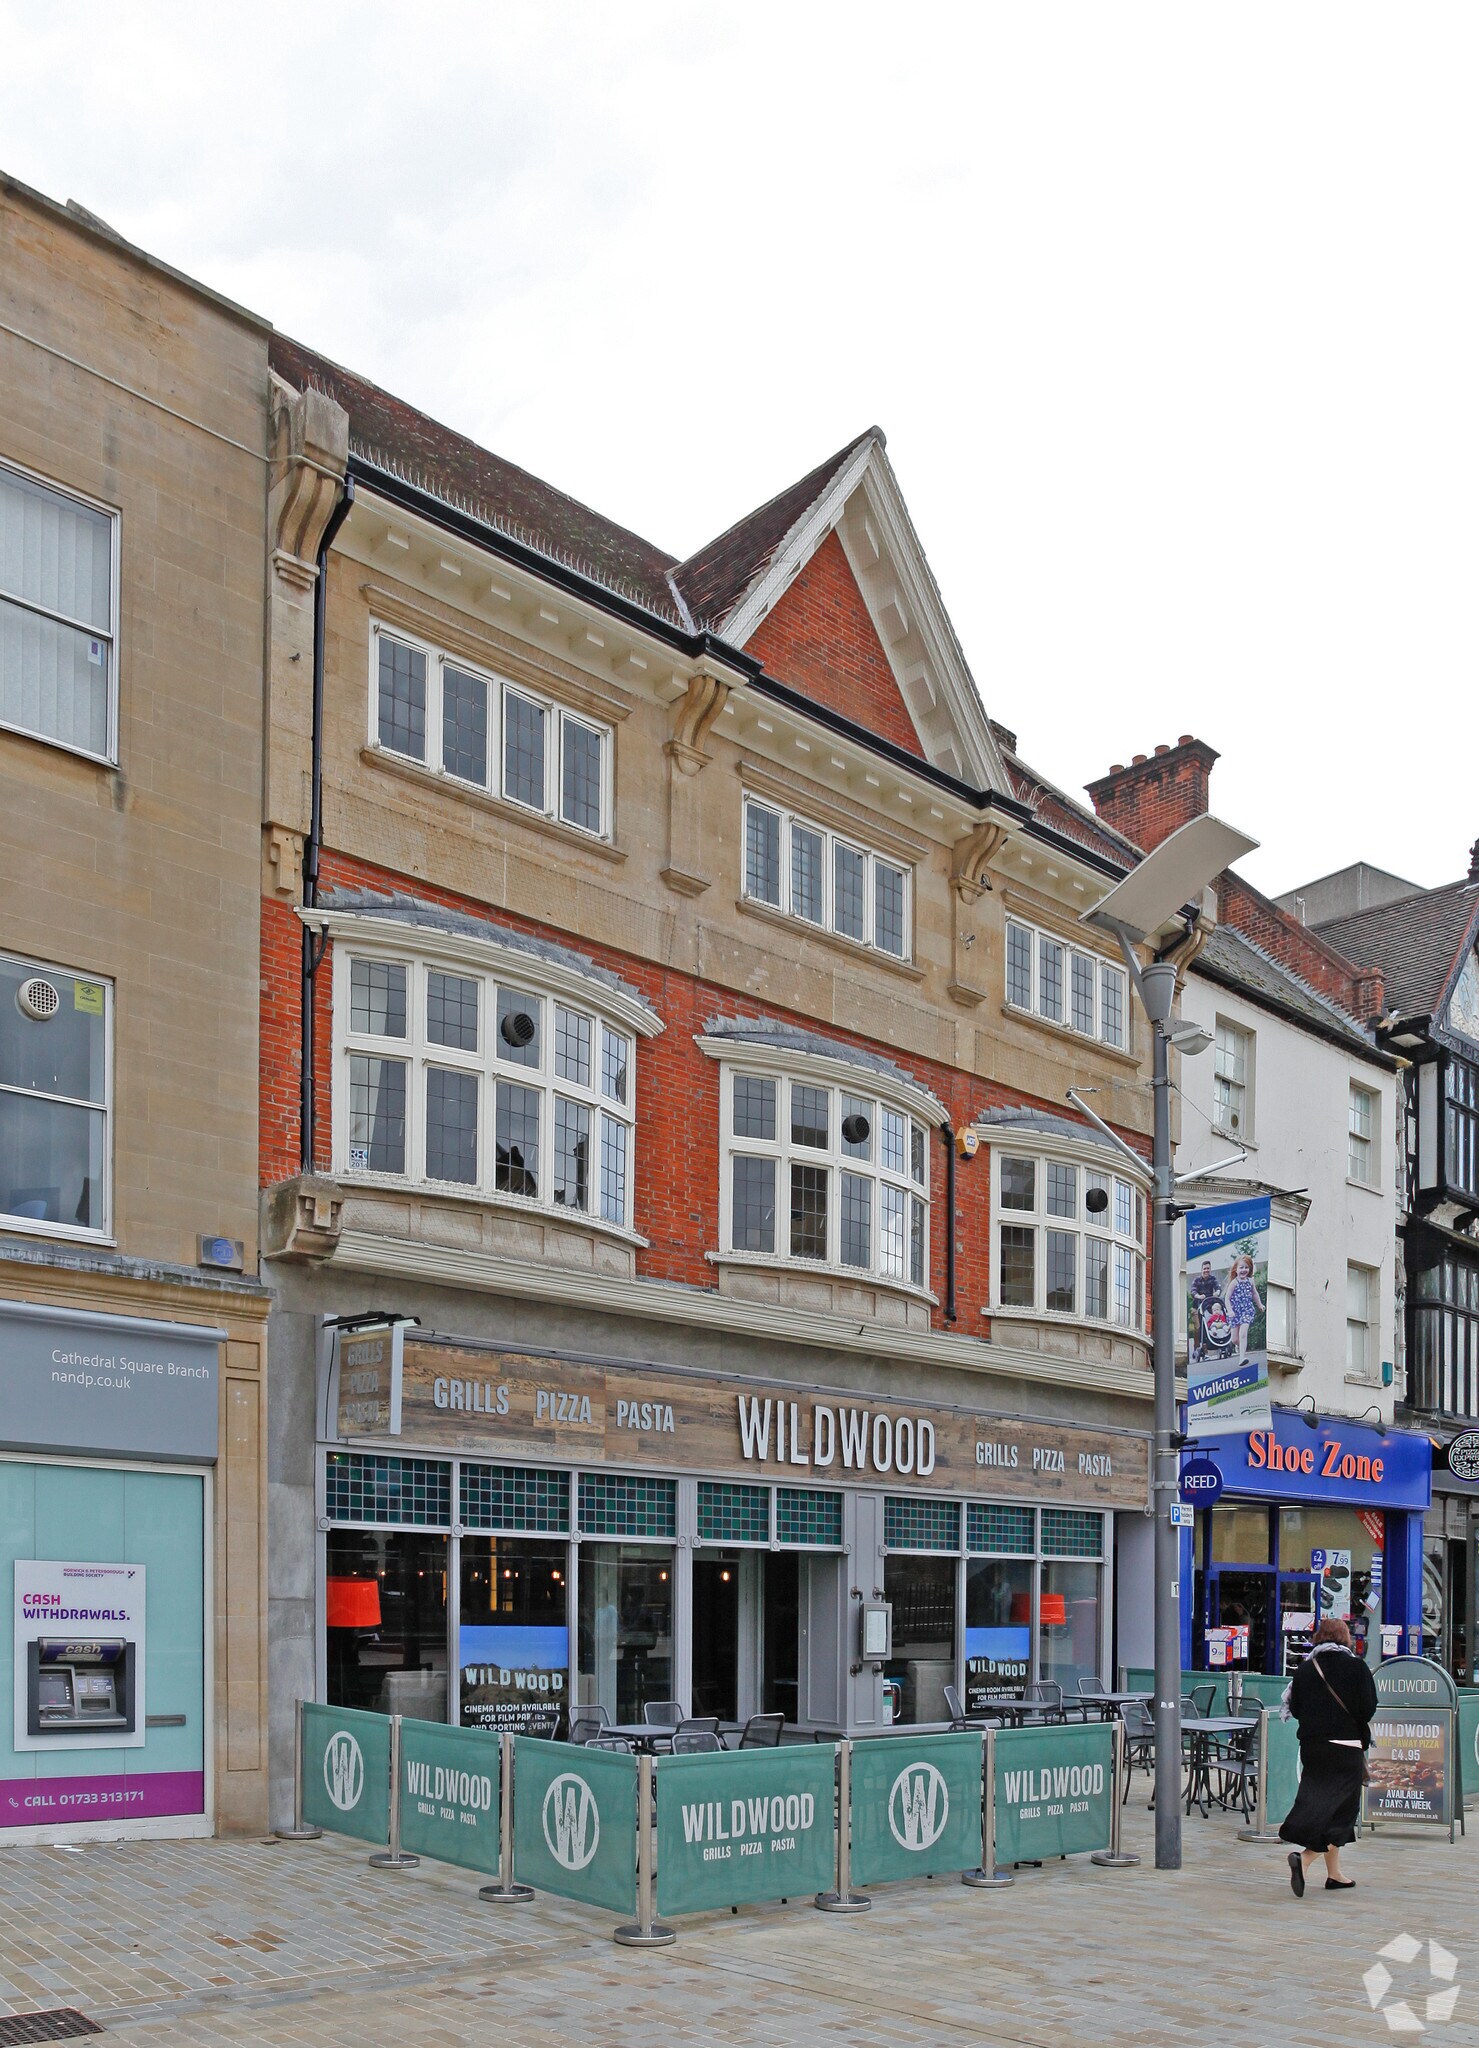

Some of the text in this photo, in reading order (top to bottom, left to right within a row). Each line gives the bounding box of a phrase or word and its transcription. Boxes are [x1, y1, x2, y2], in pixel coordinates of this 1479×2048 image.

[348, 1341, 383, 1367] GRILLS
[52, 1349, 209, 1379] Cathedral Square Branch
[51, 1371, 131, 1389] nandp.co.uk
[351, 1371, 379, 1394] PIZZA
[1193, 1376, 1250, 1400] Walking...
[433, 1377, 675, 1433] GRILLS PIZZA PASTA
[738, 1395, 935, 1476] WILDWOOD
[975, 1441, 1112, 1477] GRILLS PIZZA PASTA
[1248, 1430, 1384, 1483] Shoe Zone
[1184, 1475, 1217, 1489] REED
[23, 1594, 61, 1605] CASH
[23, 1608, 130, 1620] WITHDRAWALS.
[65, 1643, 101, 1655] cash
[1378, 1679, 1437, 1693] WILDWOOD
[464, 1702, 560, 1713] CINEMA ROOM AVAILABLE
[480, 1714, 495, 1723] FOR
[498, 1713, 515, 1722] FILM
[489, 1723, 526, 1731] SPORTING
[1373, 1722, 1440, 1738] WILDWOOD
[1419, 1739, 1440, 1748] PIZZA
[1391, 1748, 1421, 1761] £4.95
[407, 1760, 491, 1811] WILDWOOD
[1004, 1764, 1104, 1804] WILDWOOD
[24, 1790, 144, 1807] CALL 01733 313171
[1386, 1789, 1425, 1800] AVAILABLE
[418, 1801, 477, 1826] GRILLS PIZZA PASTA
[1020, 1801, 1089, 1820] GRILLS PIZZA PASTA
[1379, 1799, 1431, 1810] 7 DAYS A WEEK
[682, 1793, 815, 1843] WILDWOOD
[703, 1837, 795, 1861] GRILLS PIZZA PASTA
